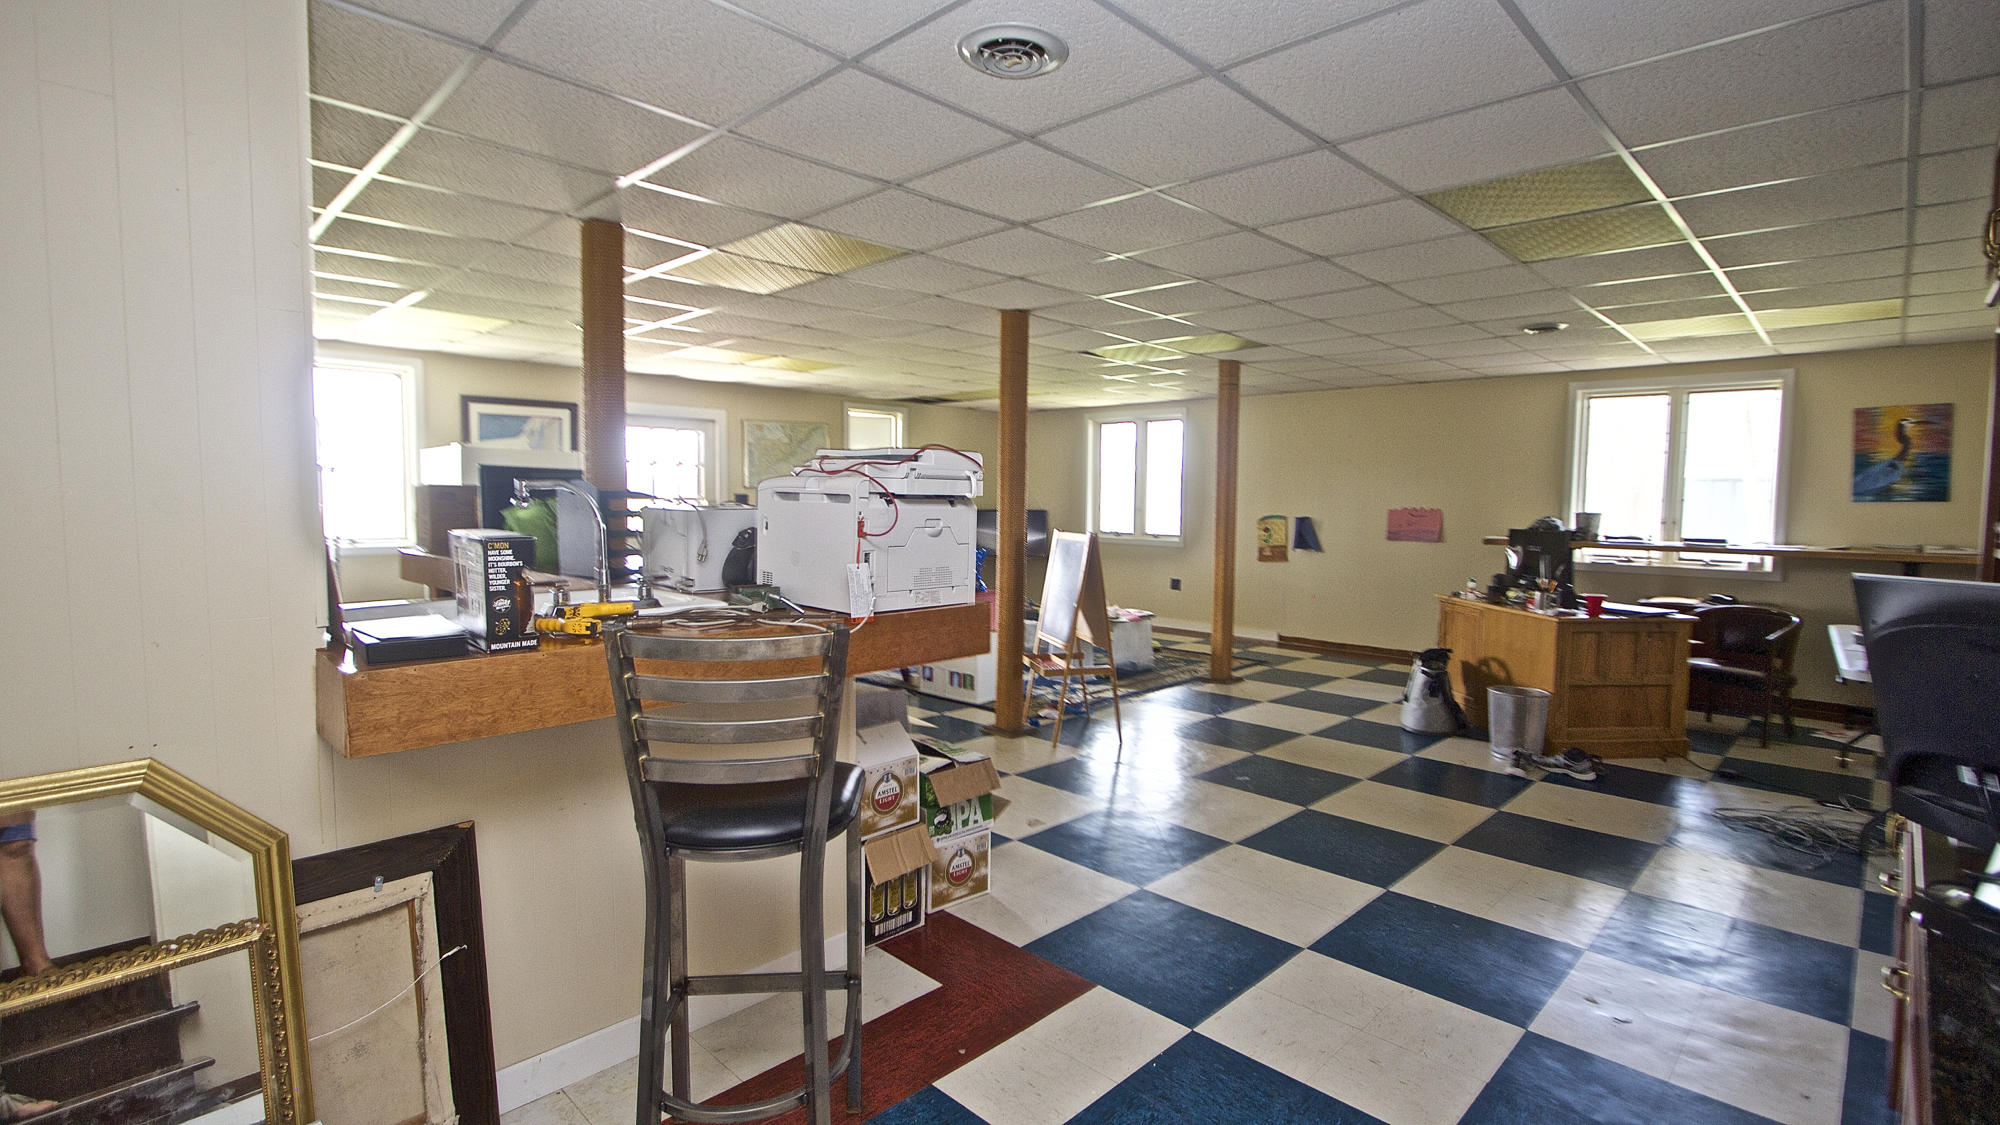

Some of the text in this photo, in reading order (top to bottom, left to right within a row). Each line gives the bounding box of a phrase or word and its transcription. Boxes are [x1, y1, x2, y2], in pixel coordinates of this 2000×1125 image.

[490, 639, 538, 650] MOUNTAIN MADE
[877, 786, 898, 797] AMSTEL
[879, 795, 896, 804] LIGHT
[951, 797, 984, 832] IPA
[951, 861, 971, 871] AMSTEL
[953, 868, 970, 877] LIGHT
